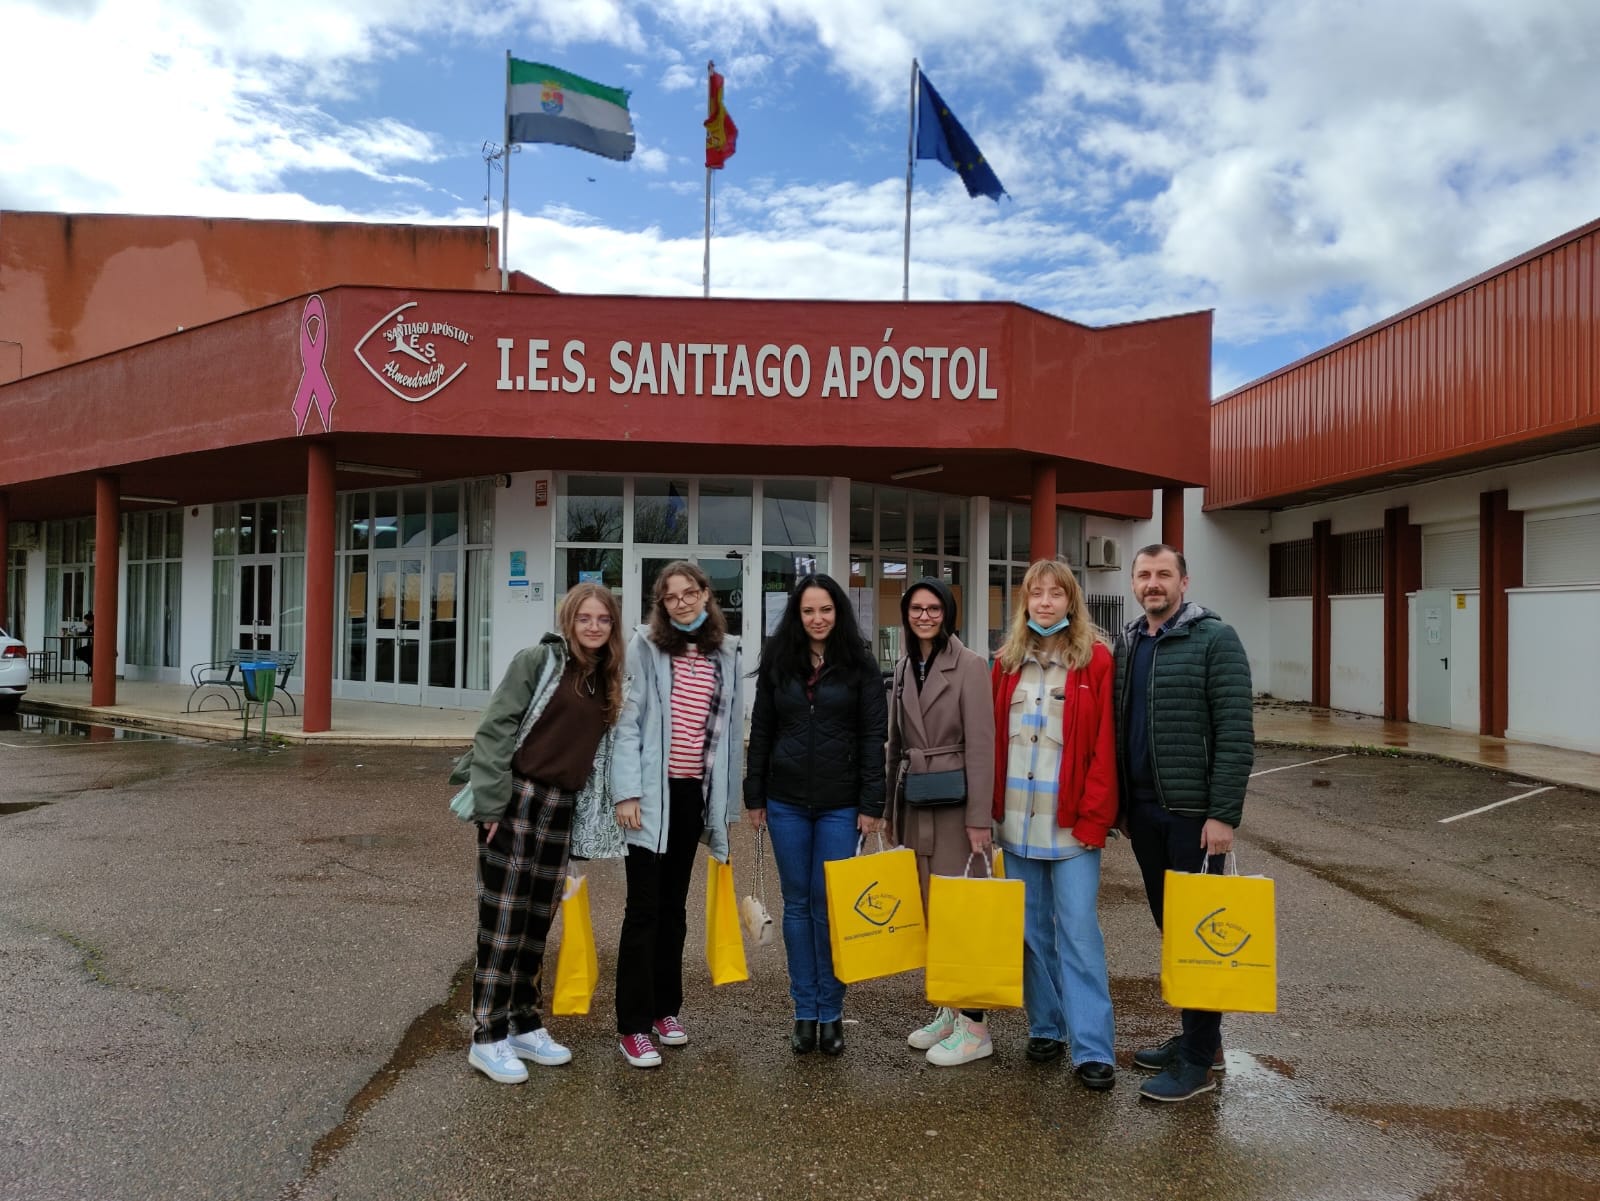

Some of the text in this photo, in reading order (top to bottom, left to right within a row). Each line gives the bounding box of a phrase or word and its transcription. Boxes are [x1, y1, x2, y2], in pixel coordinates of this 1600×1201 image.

[382, 360, 445, 388] Almendralejo
[496, 327, 998, 400] I.E.S. SANTIAGO APÓSTOL
